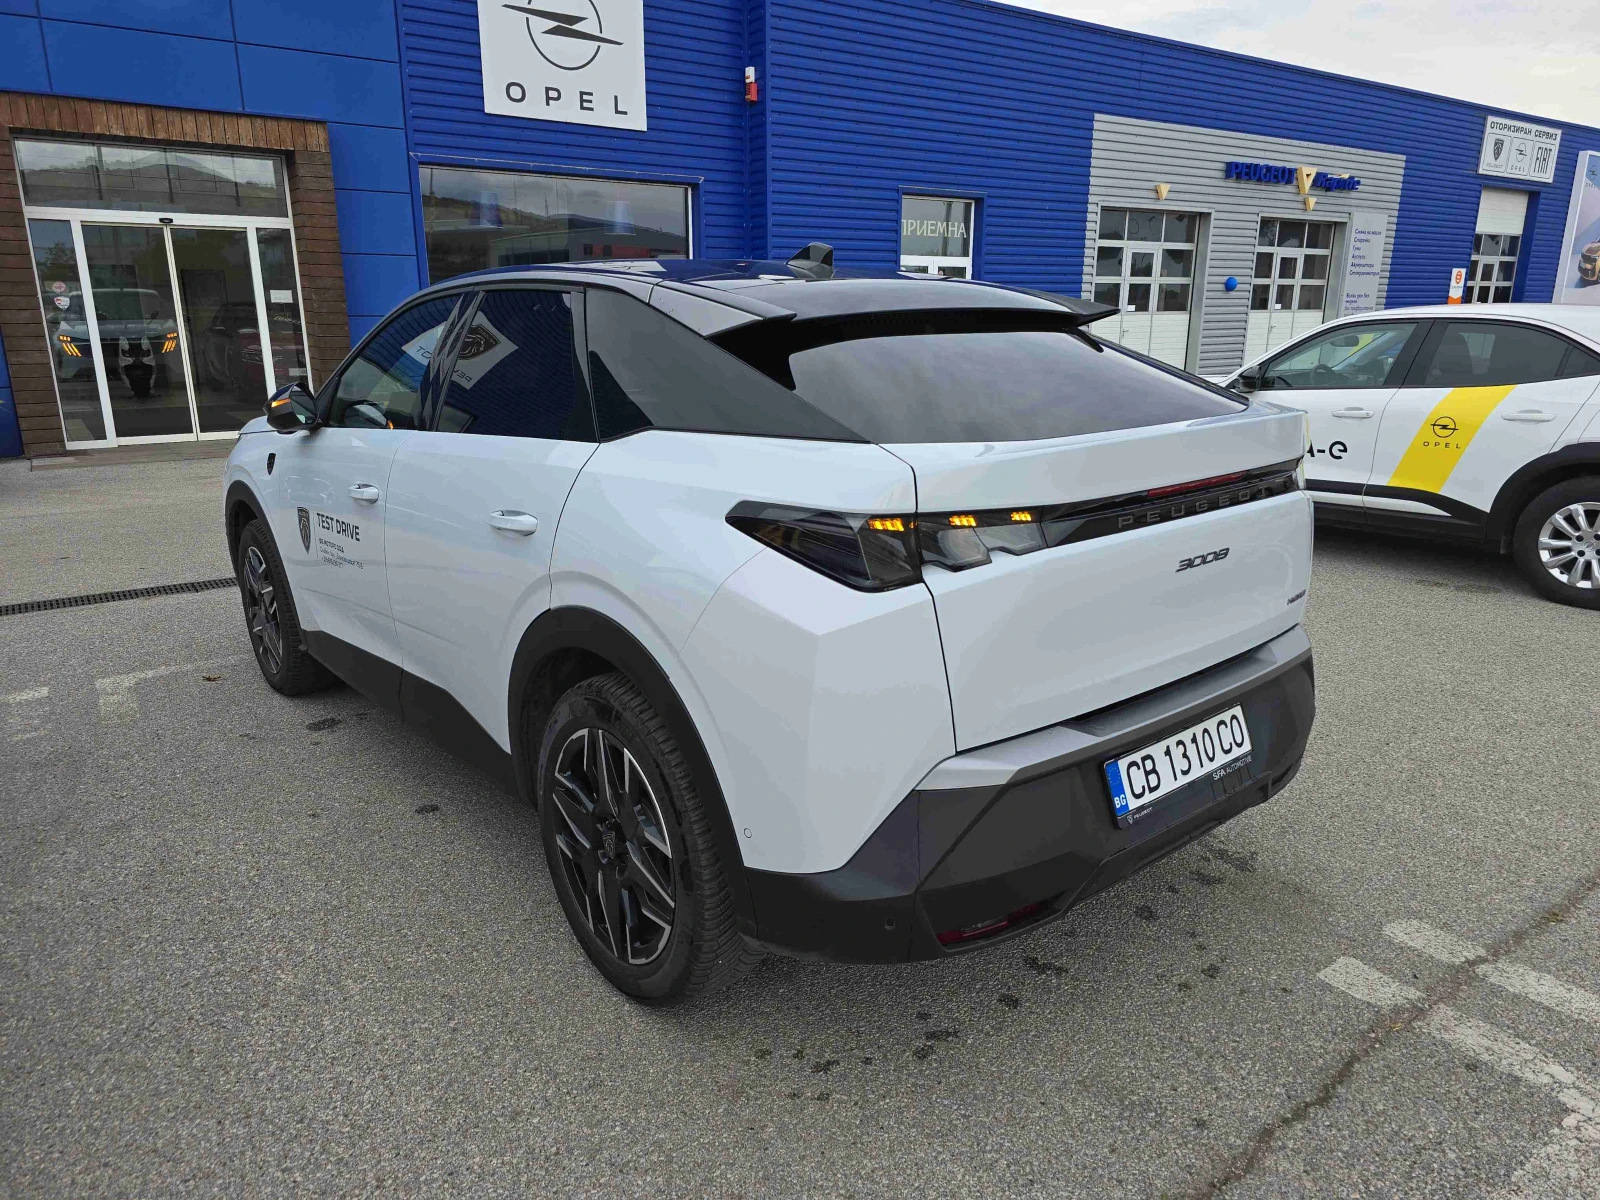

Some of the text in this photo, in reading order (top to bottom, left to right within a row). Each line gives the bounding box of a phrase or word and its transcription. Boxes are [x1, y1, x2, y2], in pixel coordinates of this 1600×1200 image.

[505, 82, 628, 116] OPEL
[1490, 121, 1558, 141] ОТОРИЗИРАН СЕРВИЗ
[1510, 164, 1525, 172] OPEL
[1533, 146, 1552, 174] FIAT
[1225, 161, 1297, 184] PEUGEOT
[1311, 171, 1361, 191] Rapide
[901, 219, 967, 238] ПРИЕМНА
[1423, 440, 1461, 449] OPEL
[1118, 485, 1268, 529] PEUGEOT
[316, 512, 361, 542] TEST DRIVE
[1175, 547, 1230, 573] 3008
[1126, 713, 1245, 800] CB 1310 CO
[1212, 755, 1253, 780] SFA AUTOMOTIVE
[1113, 793, 1127, 809] BG
